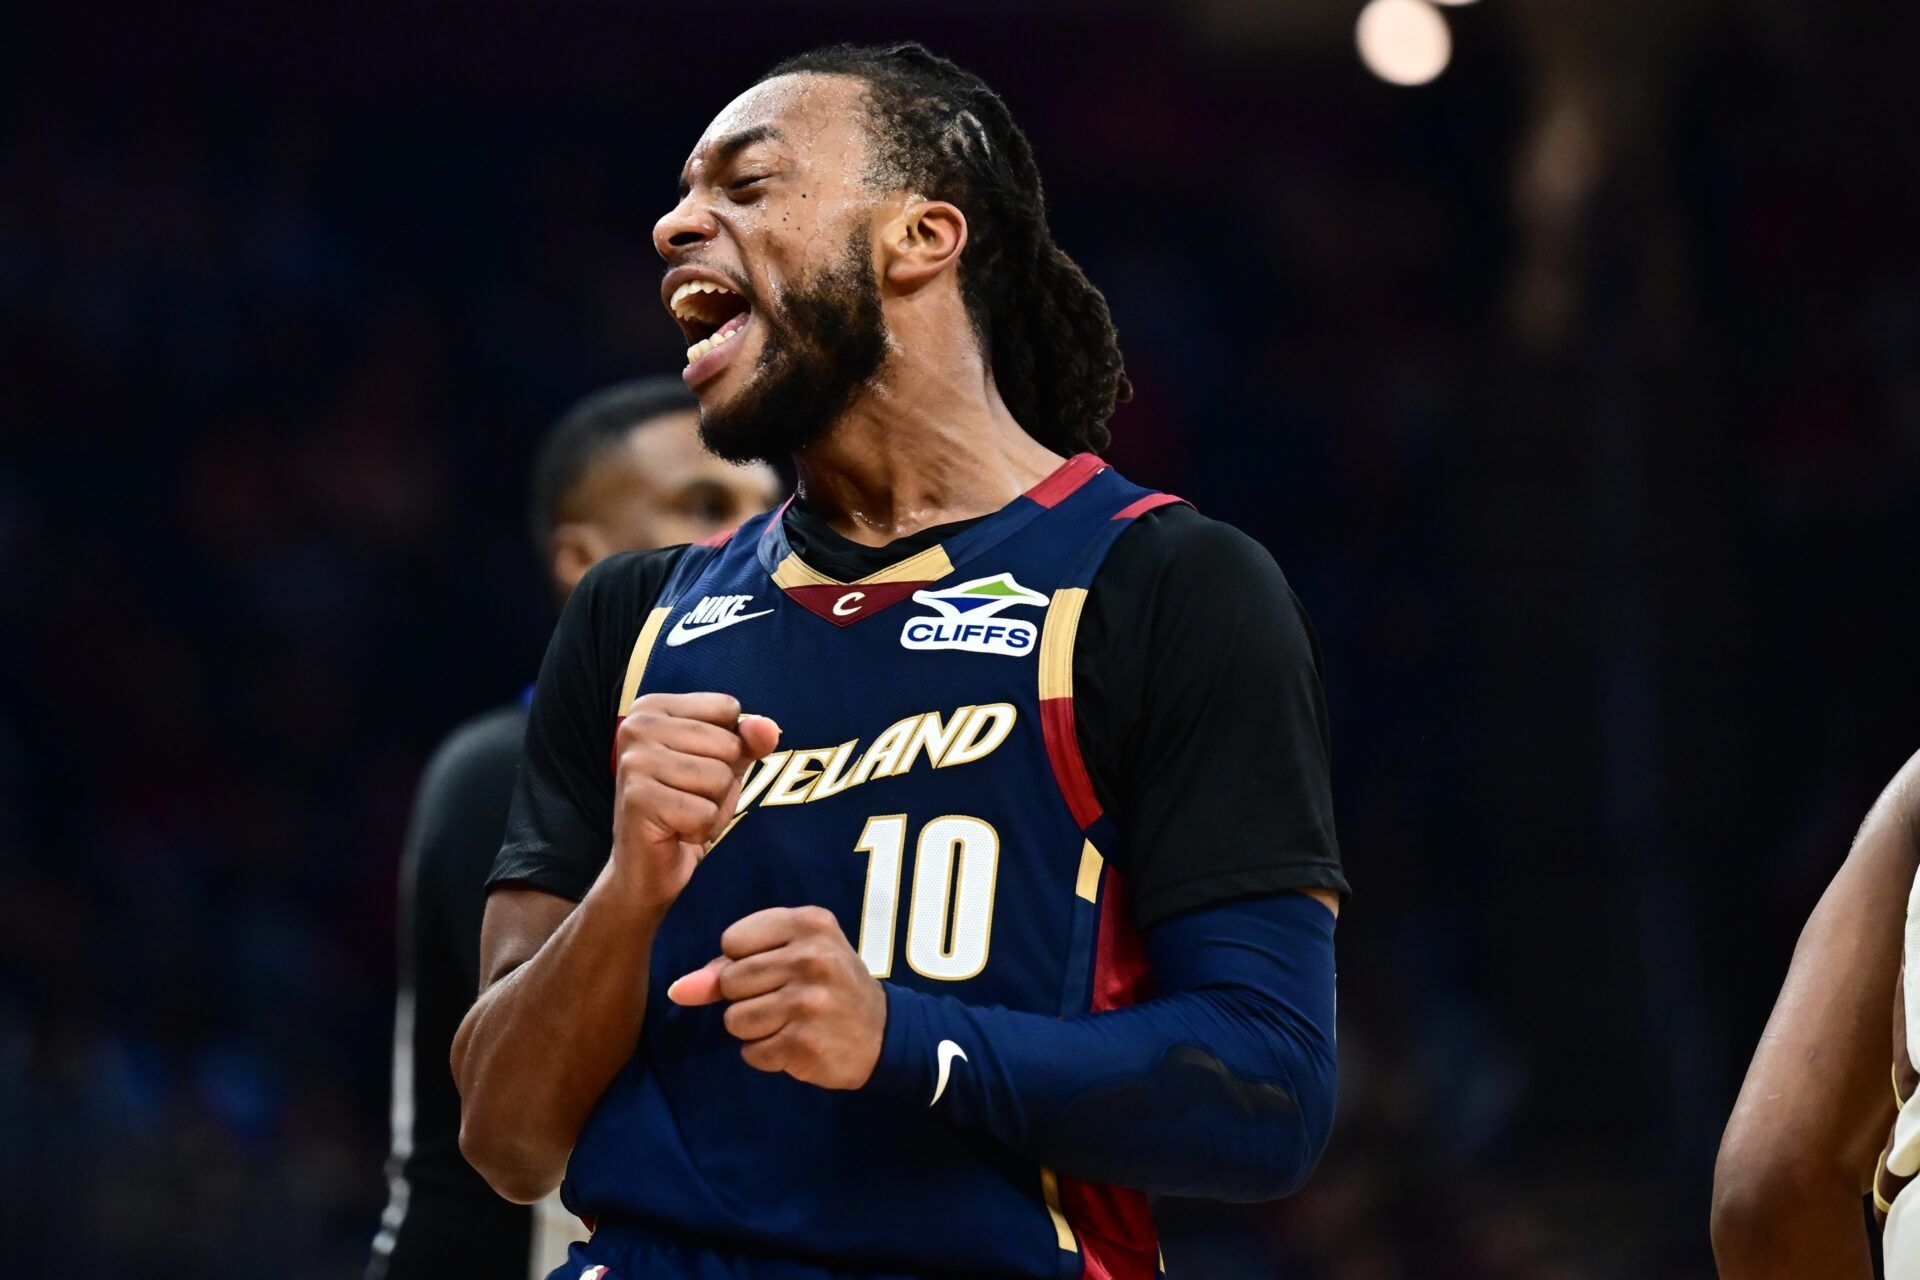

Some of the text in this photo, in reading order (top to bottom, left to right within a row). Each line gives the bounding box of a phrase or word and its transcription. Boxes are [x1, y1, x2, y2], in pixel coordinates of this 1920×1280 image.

[685, 595, 754, 625] NIKE
[907, 624, 1031, 648] CLIFFS
[714, 702, 1018, 838] VELAND
[853, 814, 1000, 981] 10
